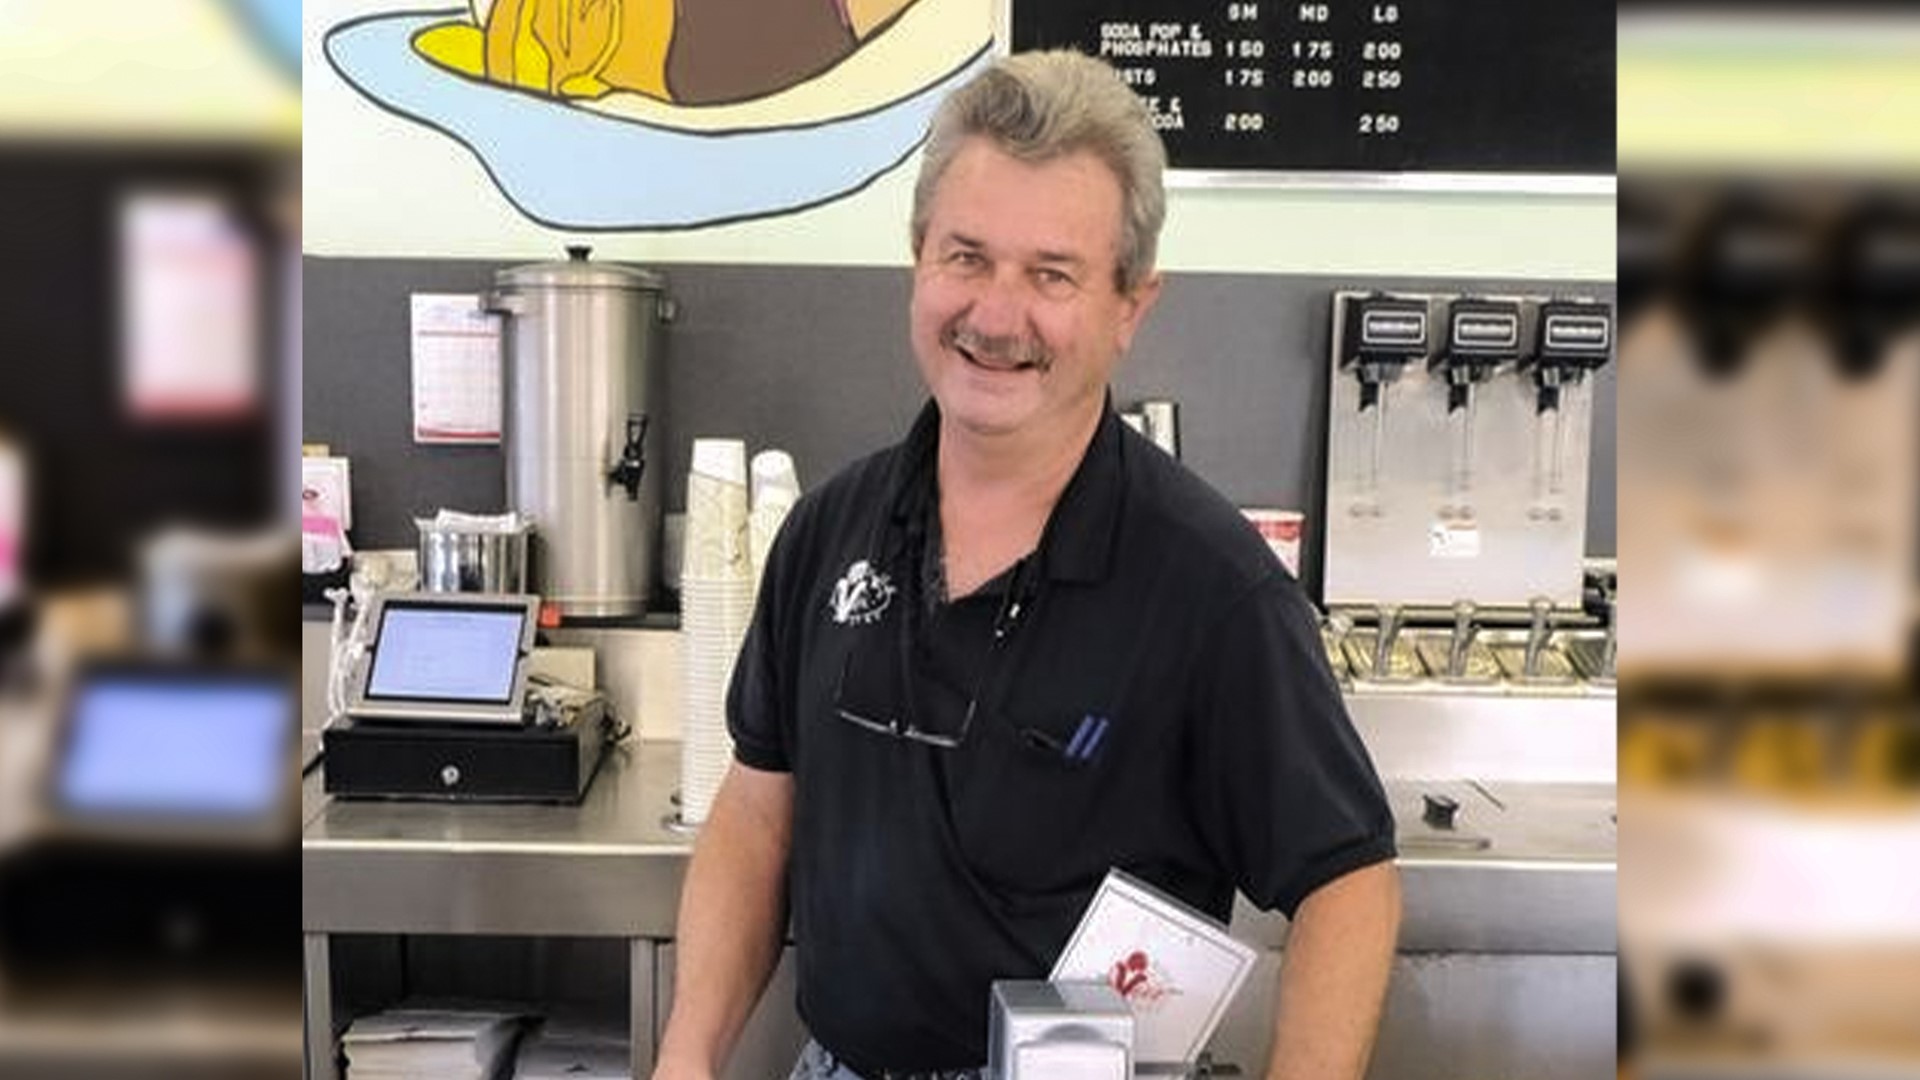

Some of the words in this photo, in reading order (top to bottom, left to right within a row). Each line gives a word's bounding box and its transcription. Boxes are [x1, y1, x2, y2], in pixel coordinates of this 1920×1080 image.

[1298, 4, 1329, 21] MD
[1101, 22, 1141, 39] SODA
[1149, 23, 1182, 39] POP
[1189, 24, 1203, 39] &
[1101, 40, 1213, 57] PHOSPHATES
[1363, 42, 1402, 60] 200
[1293, 70, 1333, 87] 200
[1362, 70, 1402, 88] 250
[1225, 113, 1264, 130] 200
